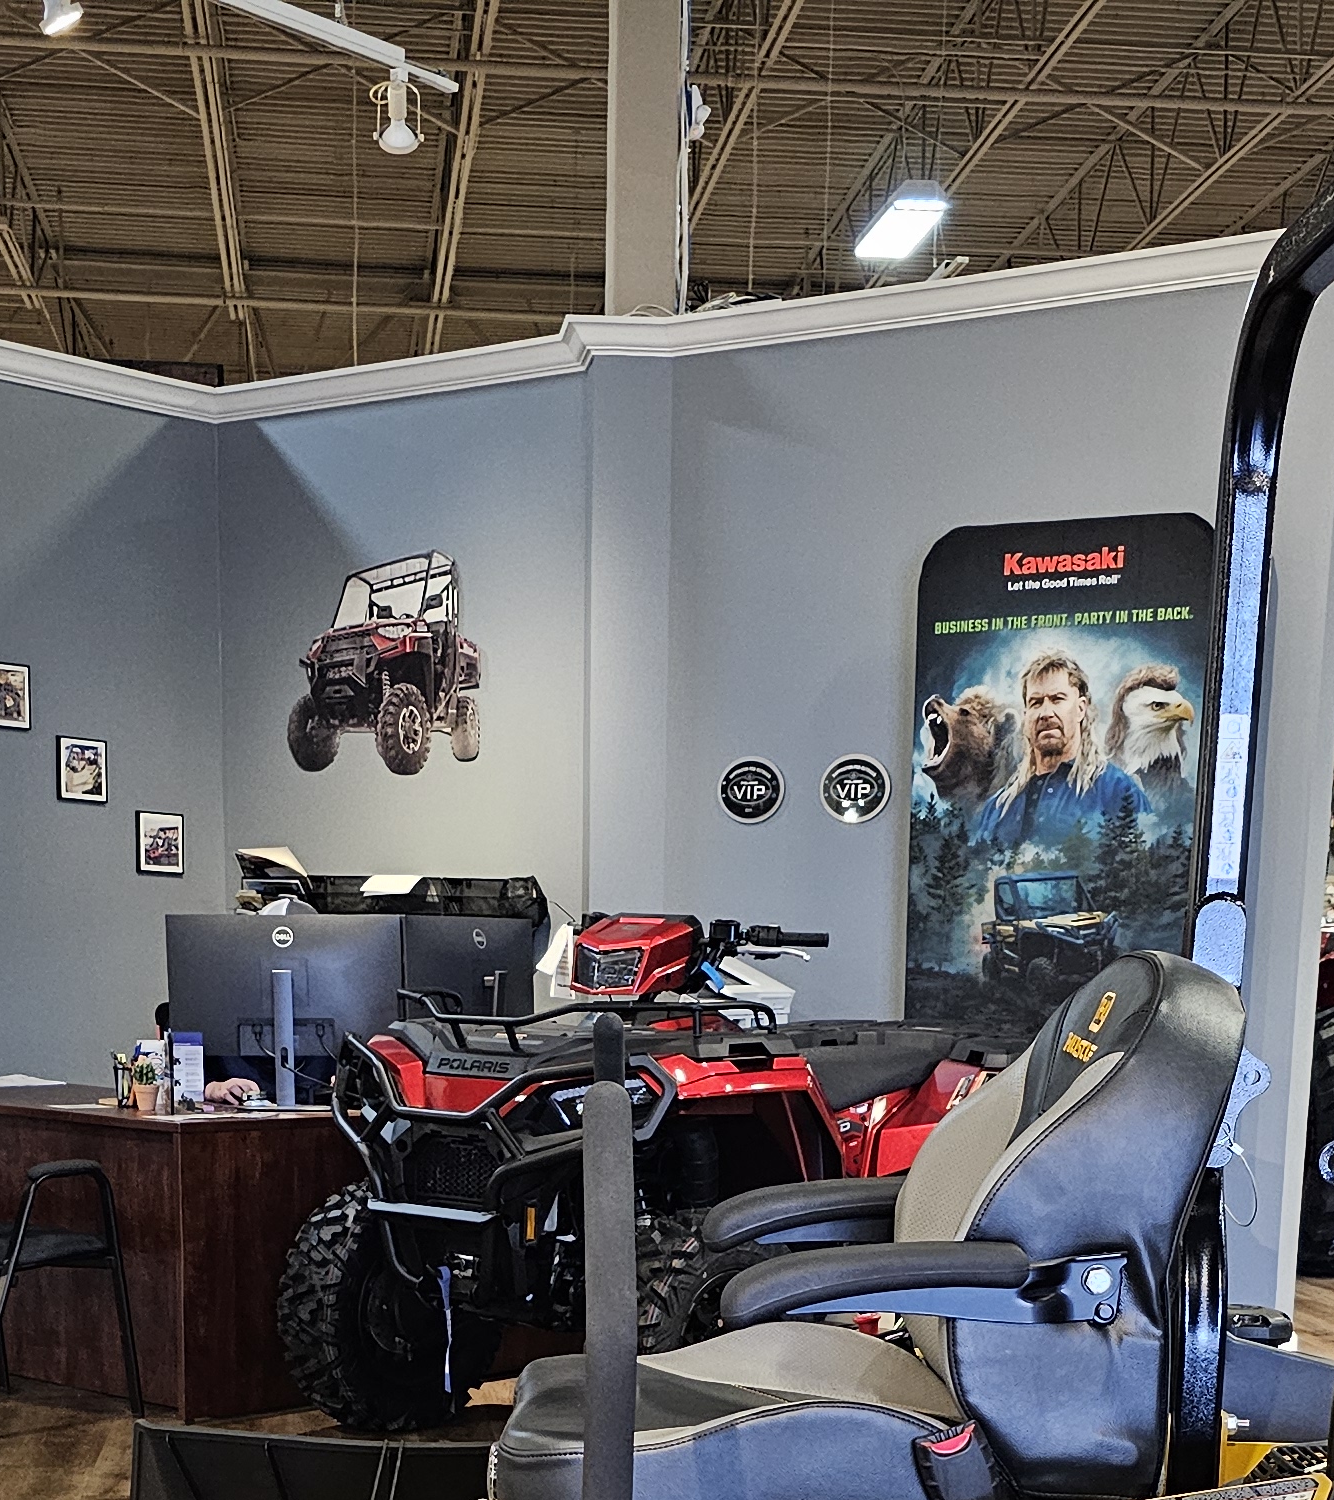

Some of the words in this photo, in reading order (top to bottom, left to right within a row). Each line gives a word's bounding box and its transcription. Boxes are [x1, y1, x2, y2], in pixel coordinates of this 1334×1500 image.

[1003, 546, 1126, 576] Kawasaki
[1008, 581, 1023, 591] Let
[1025, 579, 1040, 590] the
[1041, 578, 1067, 589] Good
[1069, 576, 1097, 587] Times
[934, 618, 989, 635] BUSINESS
[991, 616, 1004, 631] IN
[1006, 615, 1028, 630] THE
[1031, 613, 1071, 628] FRONT.
[1074, 610, 1113, 626] PARTY
[1115, 609, 1128, 623] IN
[1132, 607, 1154, 622] THE
[1157, 606, 1194, 621] BACK.
[733, 785, 766, 799] VIP
[835, 783, 871, 799] VIP
[437, 1057, 510, 1074] POLARIS
